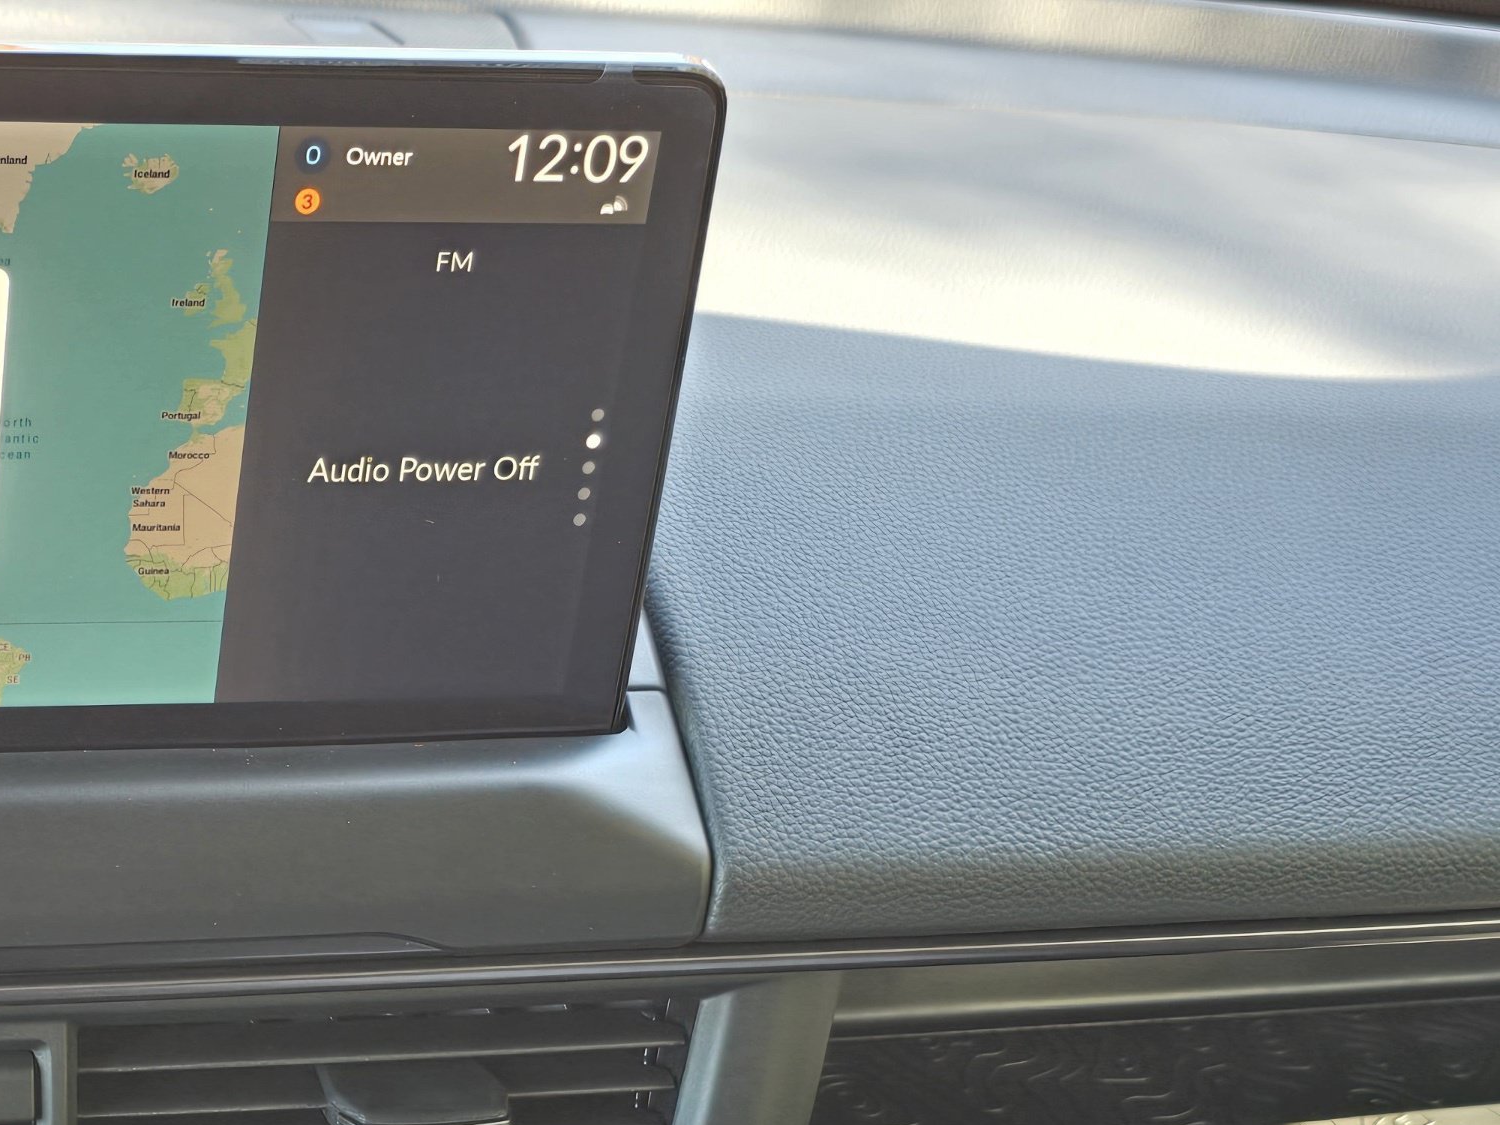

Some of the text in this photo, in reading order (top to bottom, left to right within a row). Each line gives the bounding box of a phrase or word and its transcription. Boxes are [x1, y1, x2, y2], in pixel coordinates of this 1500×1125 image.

[346, 147, 413, 166] Owner
[507, 134, 650, 184] 12:09
[133, 168, 171, 180] Iceland
[435, 251, 474, 273] FM
[171, 297, 206, 308] Ireland
[161, 411, 201, 422] Portugal
[3, 417, 33, 428] orth
[168, 451, 210, 460] Morocco
[307, 455, 540, 483] Audio Power Off
[131, 486, 170, 495] Western
[132, 499, 166, 508] Sahara
[132, 523, 181, 532] Mauritania
[137, 566, 170, 576] Guinea
